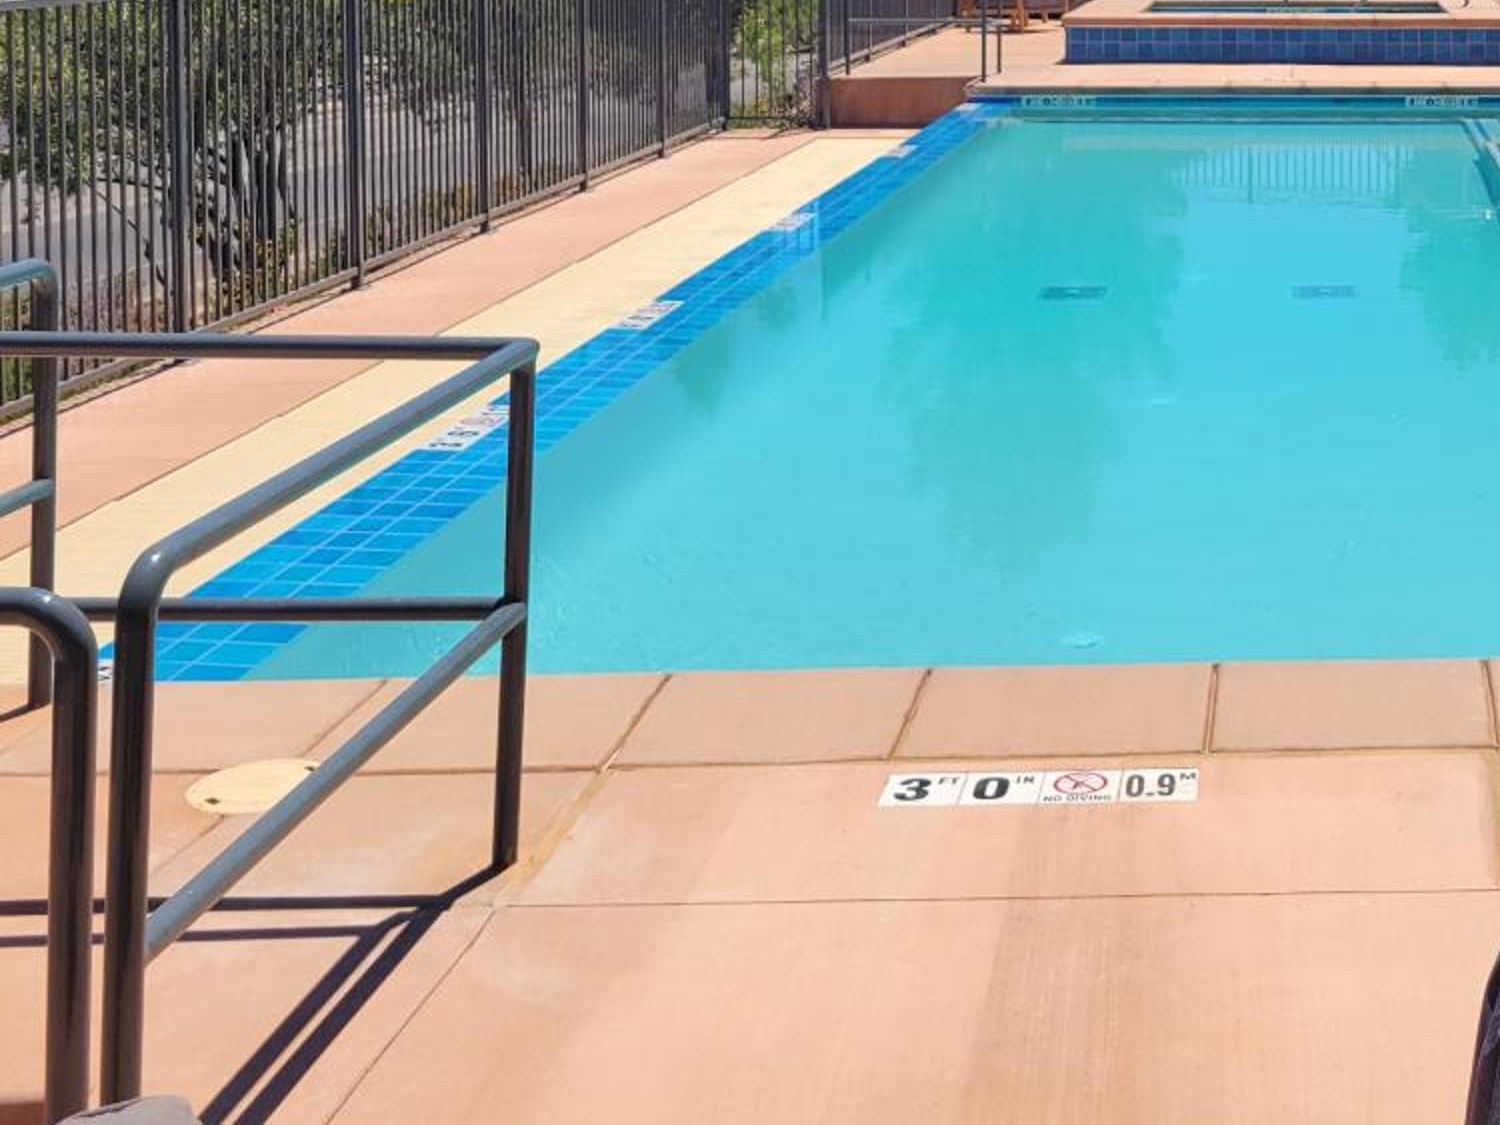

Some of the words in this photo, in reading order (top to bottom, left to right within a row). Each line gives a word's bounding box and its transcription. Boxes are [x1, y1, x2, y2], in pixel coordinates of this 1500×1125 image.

[893, 777, 933, 801] 3
[937, 776, 960, 785] FT
[972, 776, 1011, 800] 0
[1015, 775, 1036, 784] IN
[1125, 773, 1177, 797] 0.9
[1180, 772, 1196, 780] M
[1065, 793, 1112, 802] DIVING
